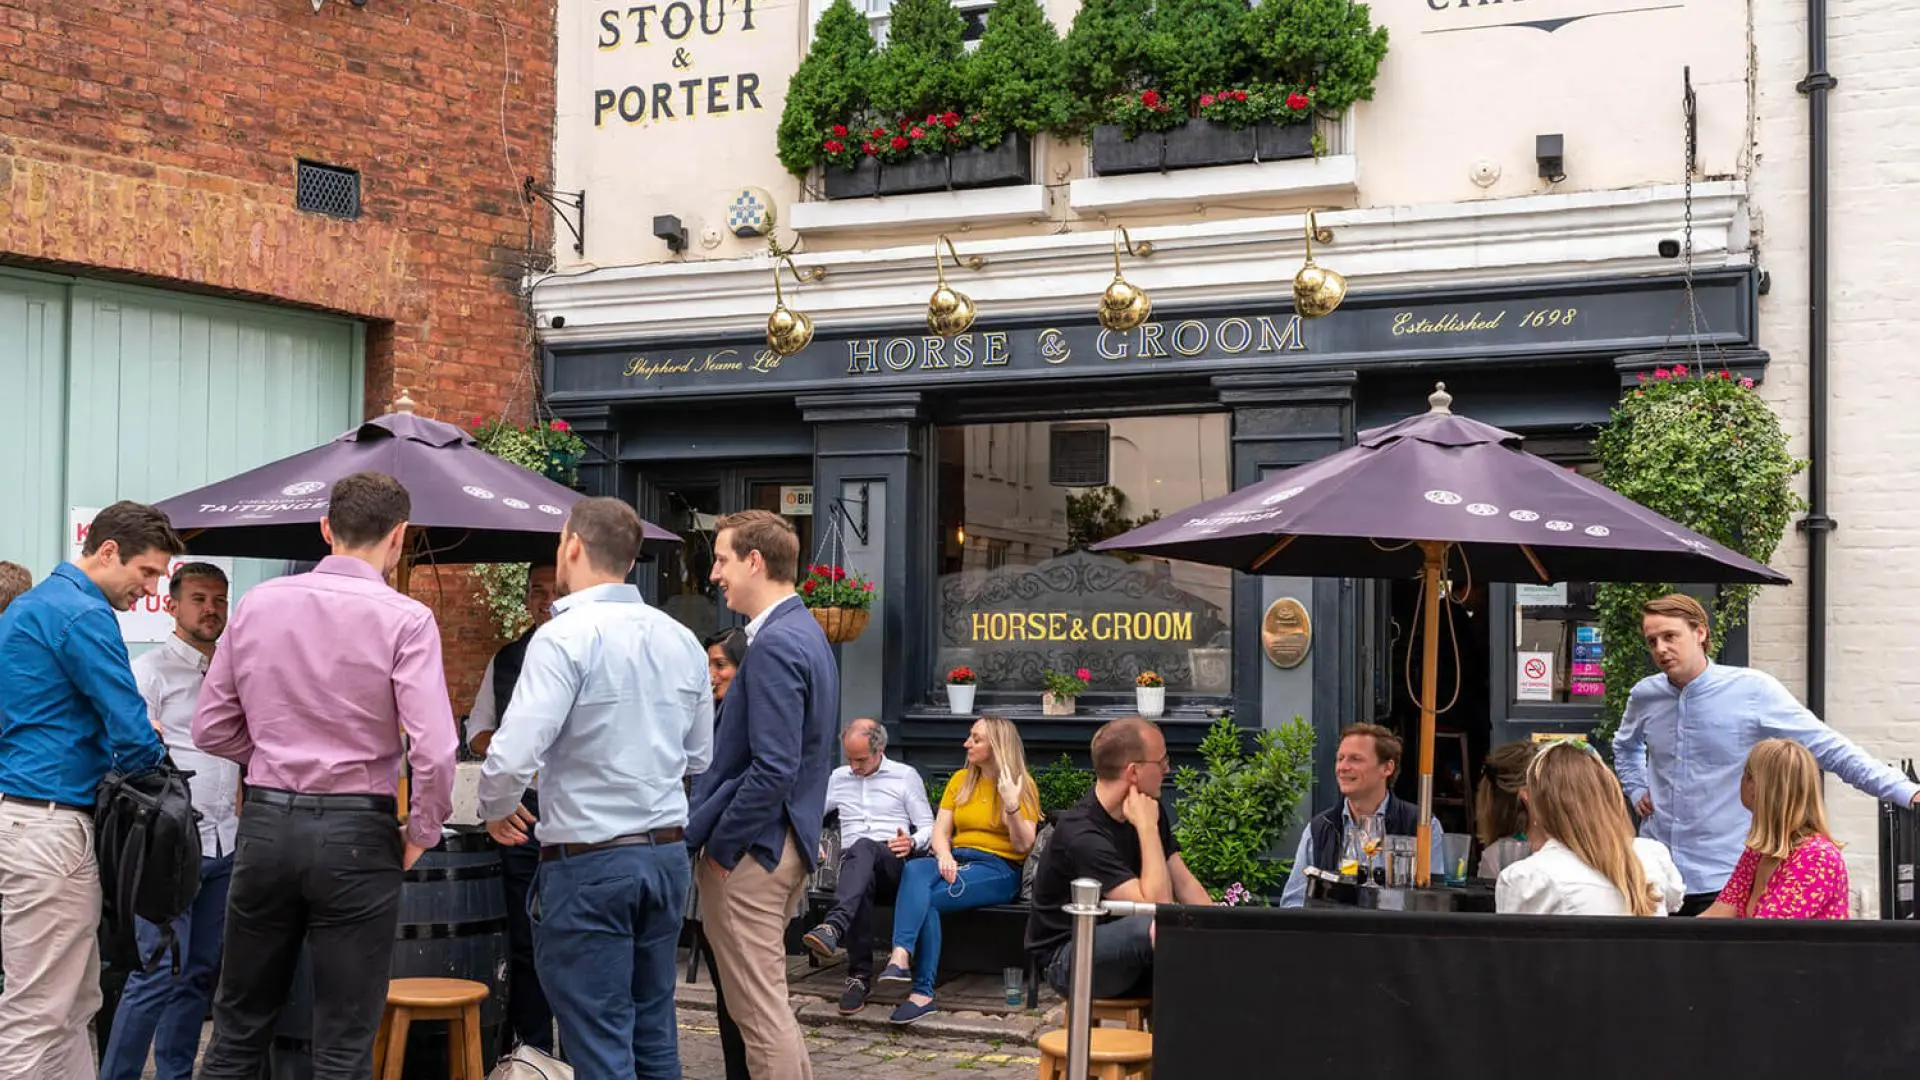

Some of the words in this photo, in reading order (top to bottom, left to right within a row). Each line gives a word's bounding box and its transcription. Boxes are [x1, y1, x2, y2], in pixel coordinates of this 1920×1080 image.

[597, 0, 757, 49] STOUT
[671, 46, 692, 68] &
[593, 72, 764, 127] PORTER
[1392, 310, 1506, 336] Established
[1518, 307, 1578, 328] 1698
[846, 330, 1011, 374] HORSE
[1037, 328, 1071, 365] &
[1096, 315, 1306, 361] GROOM
[622, 356, 692, 381] Shepherd
[748, 349, 783, 374] Ltd
[198, 500, 331, 513] TAITTINGE
